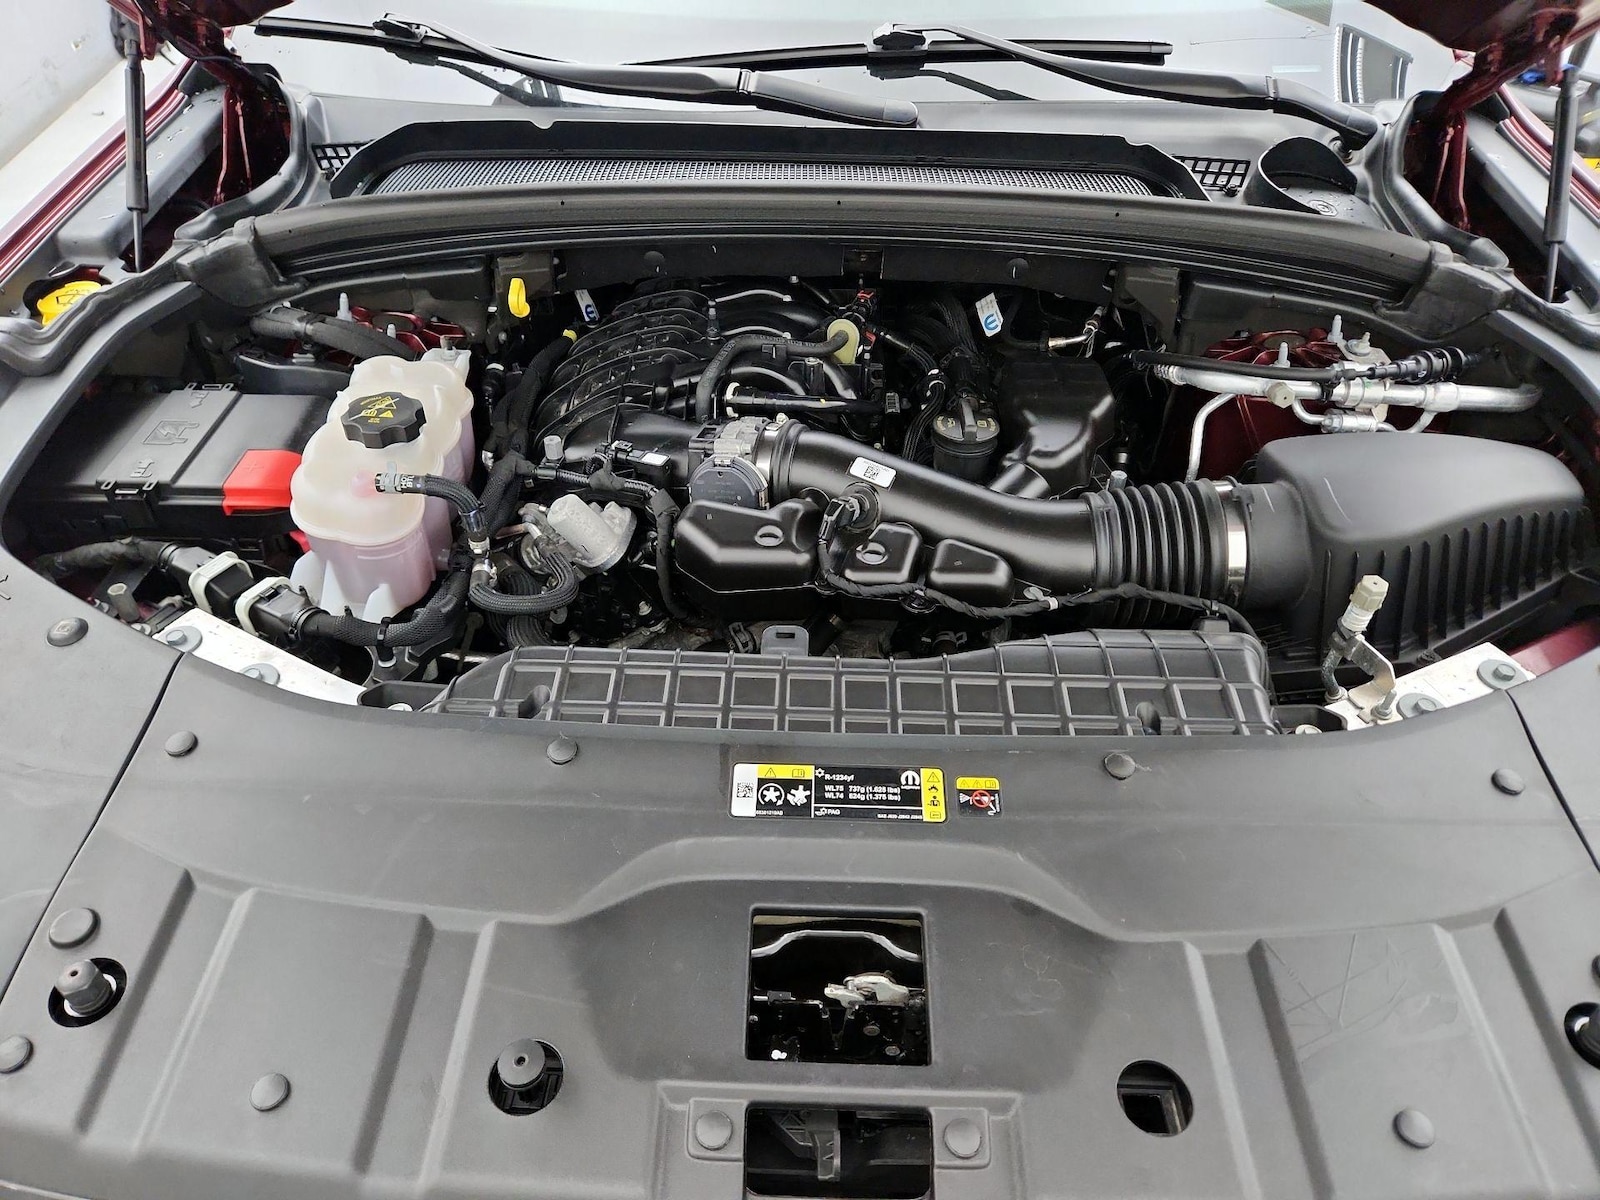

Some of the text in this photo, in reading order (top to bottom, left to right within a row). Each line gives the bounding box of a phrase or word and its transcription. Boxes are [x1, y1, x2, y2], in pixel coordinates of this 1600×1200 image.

[824, 774, 854, 782] R-1234yf
[848, 785, 865, 793] 737g
[866, 786, 886, 794] (1.625
[866, 793, 887, 801] (1.375
